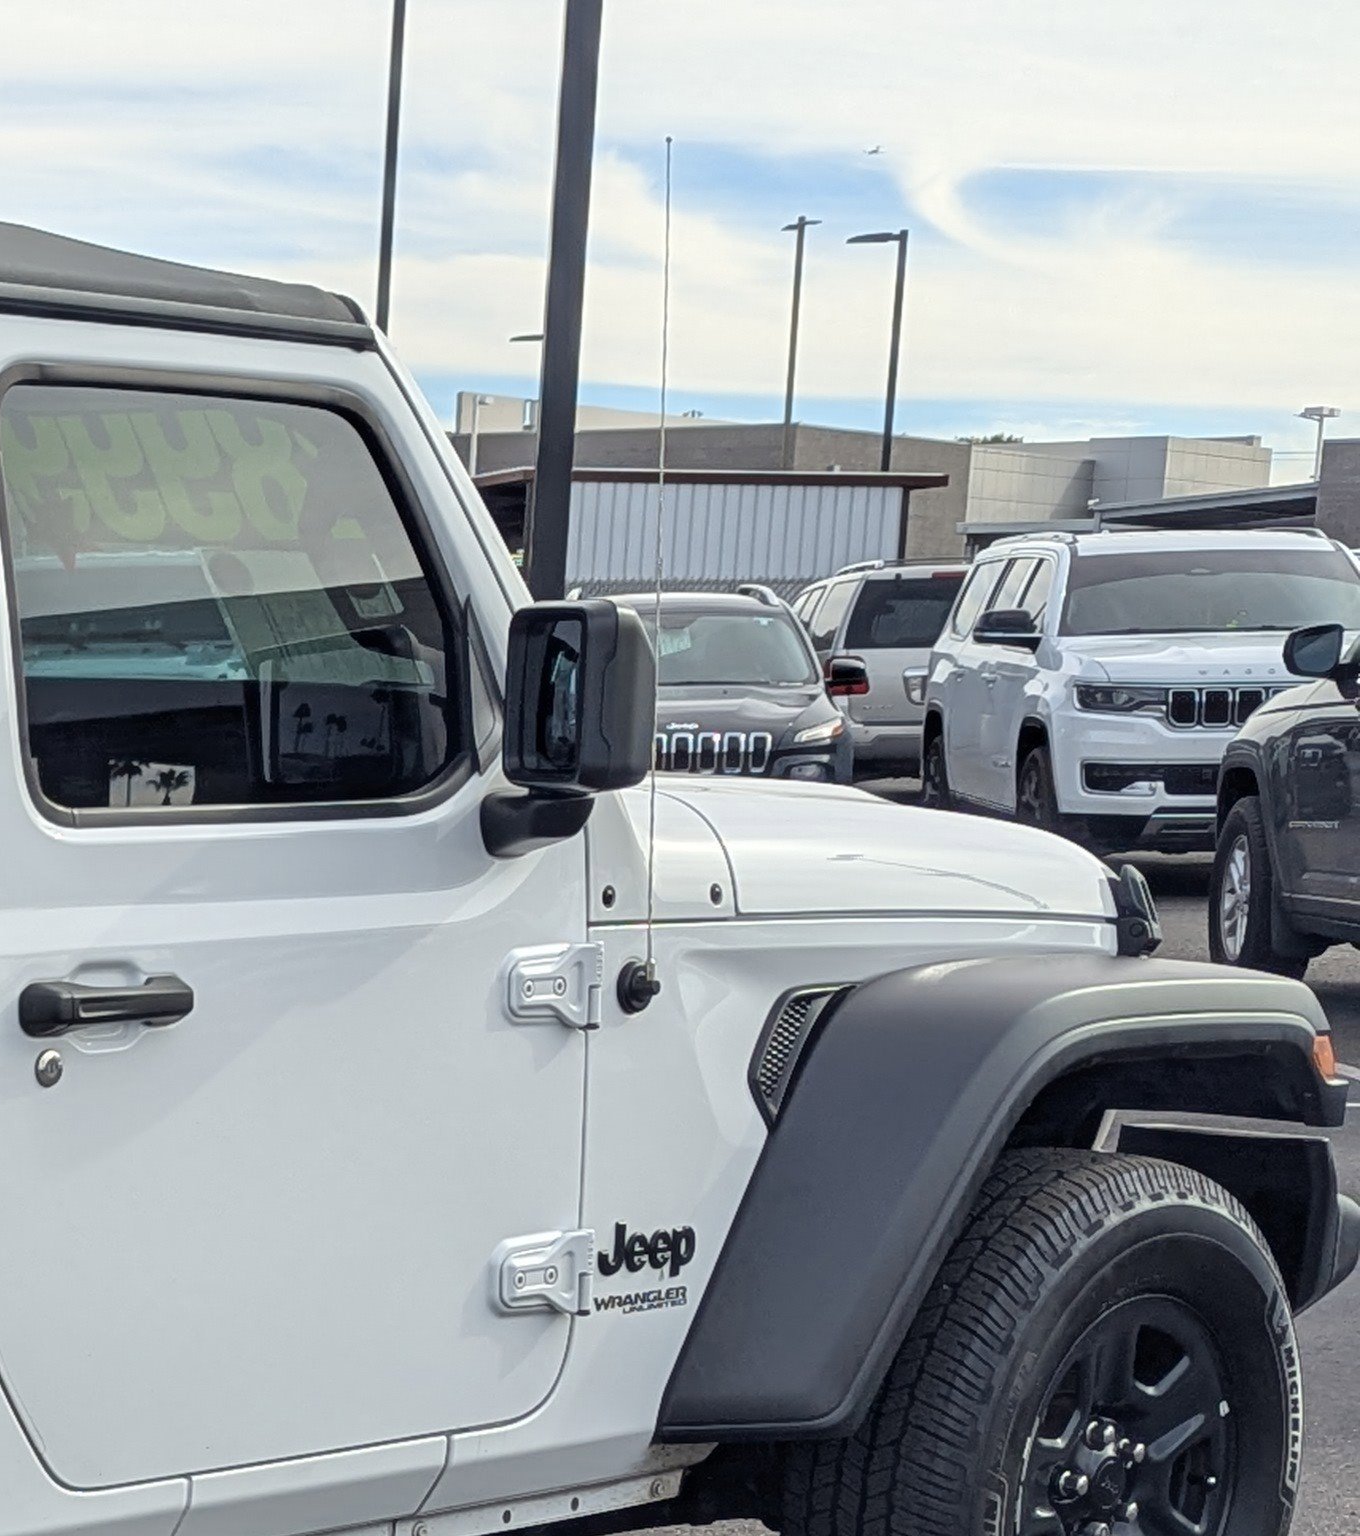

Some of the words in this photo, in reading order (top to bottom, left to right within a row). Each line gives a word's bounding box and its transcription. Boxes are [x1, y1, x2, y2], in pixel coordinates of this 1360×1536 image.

[598, 1221, 695, 1277] Jeep
[593, 1286, 687, 1311] WRANGLER
[622, 1299, 687, 1314] UNLIMITED
[1283, 1346, 1300, 1482] MICHELIN
